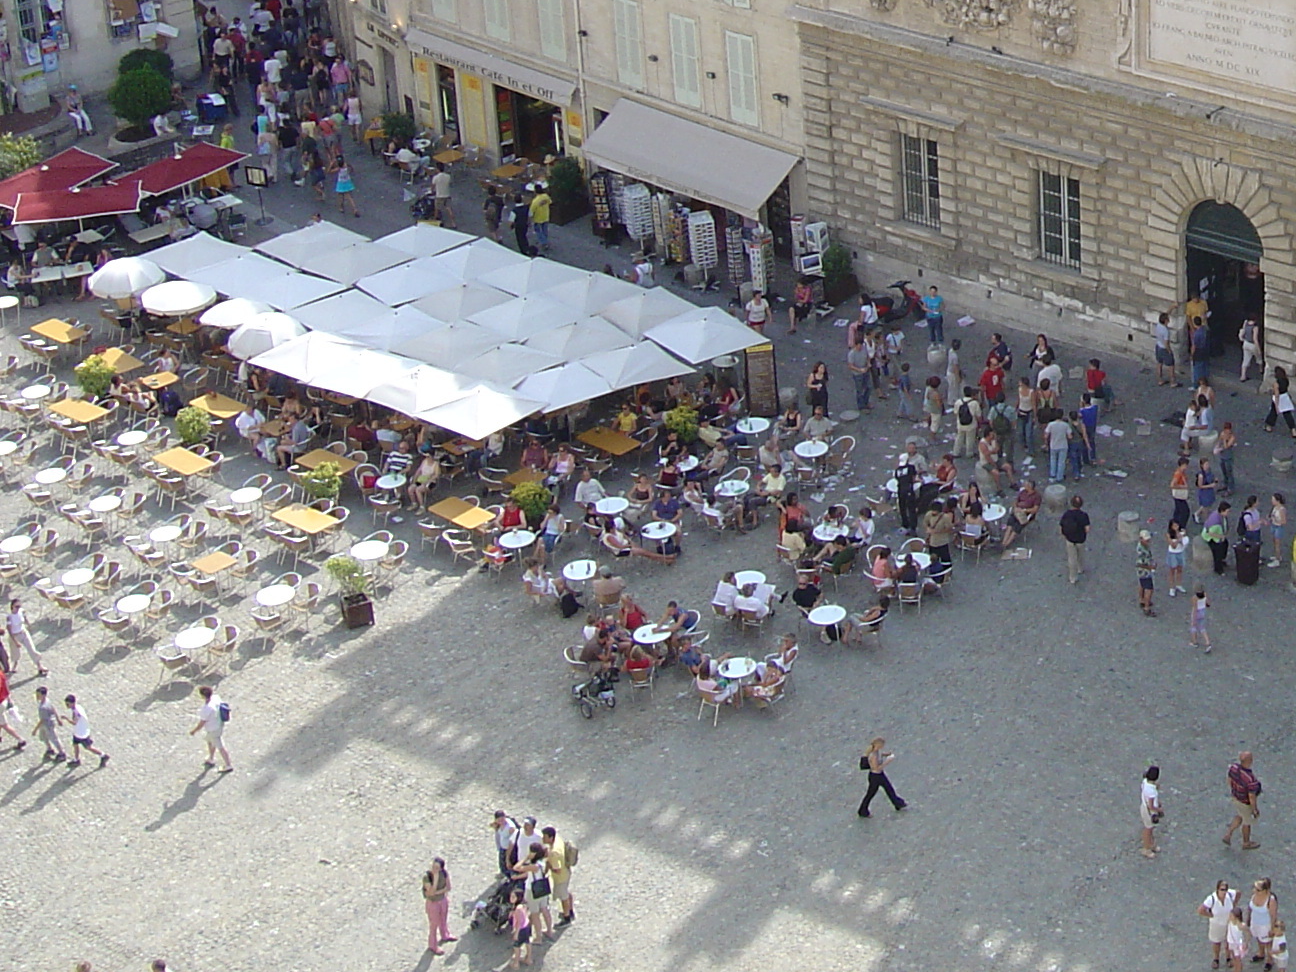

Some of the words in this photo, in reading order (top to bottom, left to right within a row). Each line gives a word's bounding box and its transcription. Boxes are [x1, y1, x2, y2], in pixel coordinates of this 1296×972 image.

[422, 46, 476, 71] Restaurant
[481, 68, 504, 81] Café
[508, 76, 518, 88] In
[522, 84, 532, 93] et
[537, 86, 554, 100] Off
[1185, 53, 1213, 66] ANNO
[1215, 60, 1224, 69] M
